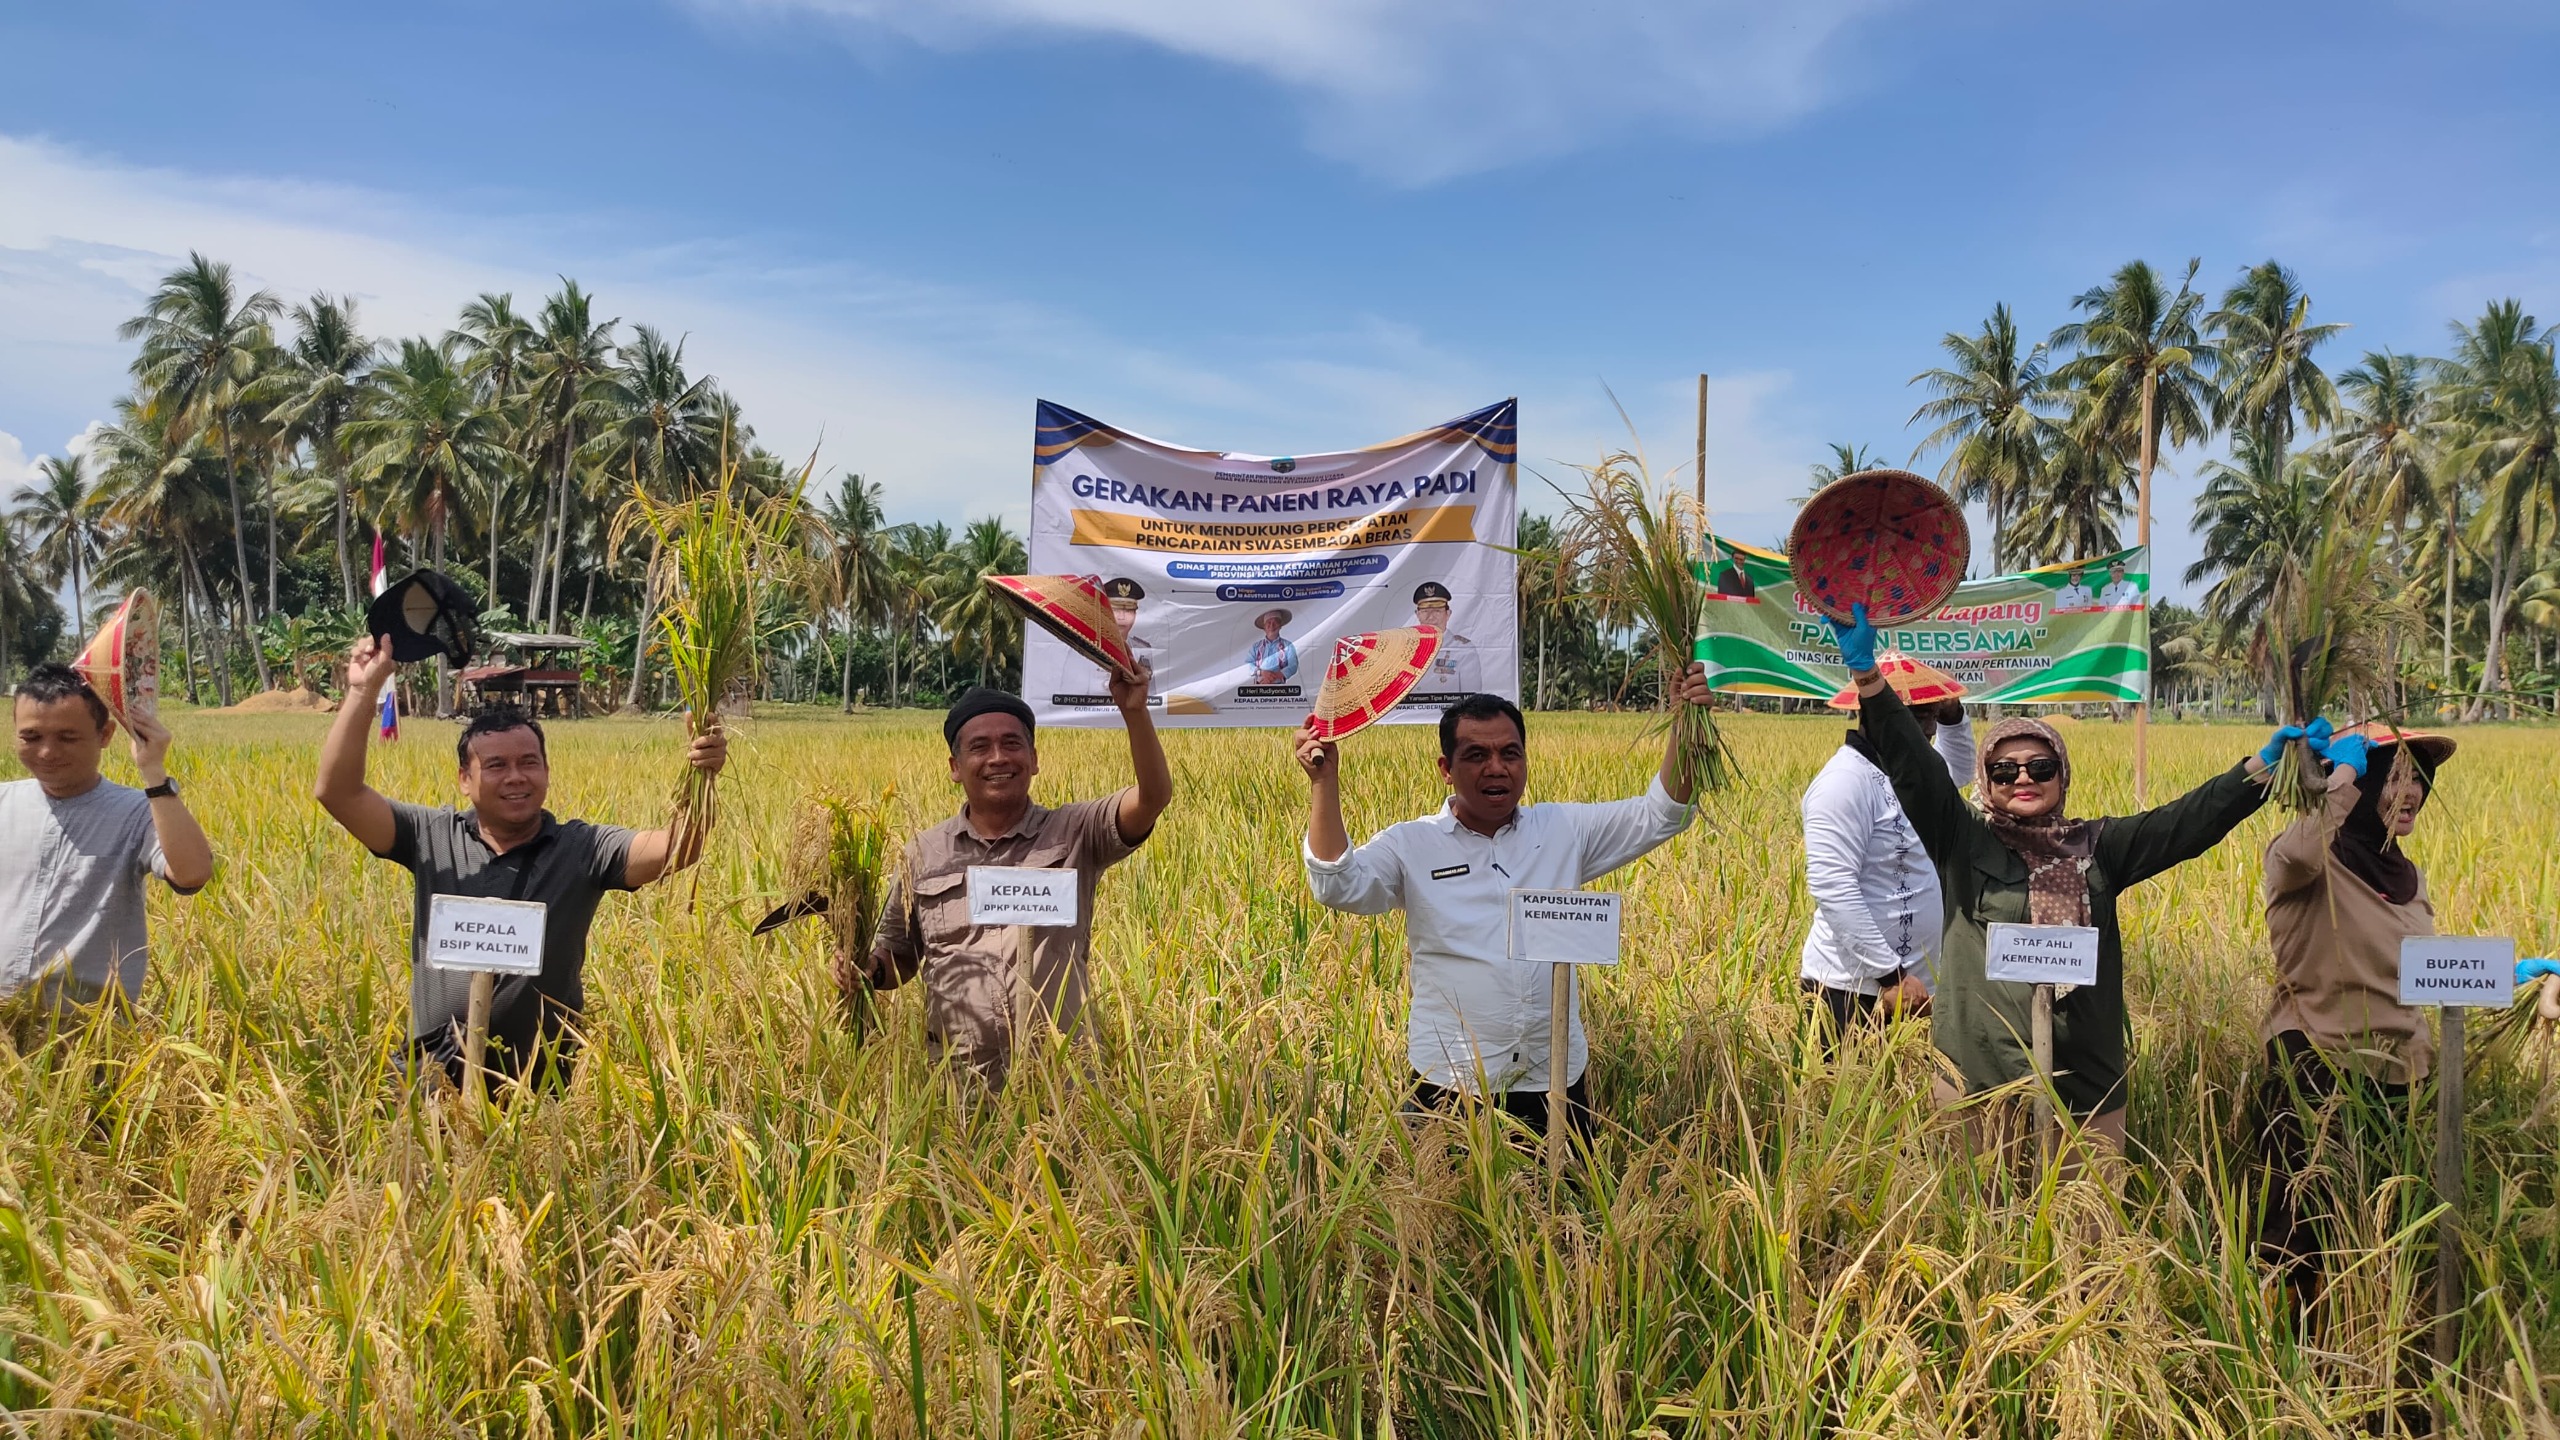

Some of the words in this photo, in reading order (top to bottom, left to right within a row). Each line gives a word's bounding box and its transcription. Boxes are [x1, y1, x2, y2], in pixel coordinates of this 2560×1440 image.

[1072, 474, 1213, 512] GERAKAN
[1221, 490, 1318, 513] PANEN
[1327, 481, 1408, 509] RAYA
[1414, 470, 1476, 498] PADI
[1140, 519, 1196, 535] UNTUK
[1200, 521, 1304, 537] MENDUKUNG
[1136, 533, 1243, 550] PENCAPAIAN
[1245, 532, 1362, 550] SWASEMBADA
[1365, 528, 1412, 544] BERAS
[1176, 563, 1205, 571] DINAS
[1207, 564, 1260, 572] PERTANIAN
[1285, 561, 1340, 571] KETAHANAN
[1342, 557, 1379, 568] PANGAN
[1257, 569, 1318, 578] KALIMANTAN
[1319, 567, 1348, 576] UTARA
[1937, 602, 2042, 626] Lapang
[1789, 622, 1891, 649] "PAN
[1897, 629, 2047, 651] BERSAMA"
[1786, 651, 1822, 663] DINAS
[1955, 660, 1980, 669] DAN
[1981, 657, 2050, 669] PERTANIAN
[991, 885, 1052, 896] KEPALA
[1523, 894, 1611, 907] KAPUSLUHTAN
[1013, 904, 1059, 912] KALTARA
[1524, 910, 1592, 922] KEMENTAN
[1596, 913, 1608, 922] RI
[454, 921, 517, 935] KEPALA
[440, 938, 471, 950] BSIP
[476, 941, 529, 954] KALTIM
[2013, 938, 2042, 947] STAF
[2045, 940, 2073, 949] AHLI
[2002, 953, 2066, 966] KEMENTAN
[2070, 958, 2082, 967] RI
[2426, 959, 2485, 970] BUPATI
[2415, 978, 2496, 989] NUNUKAN
